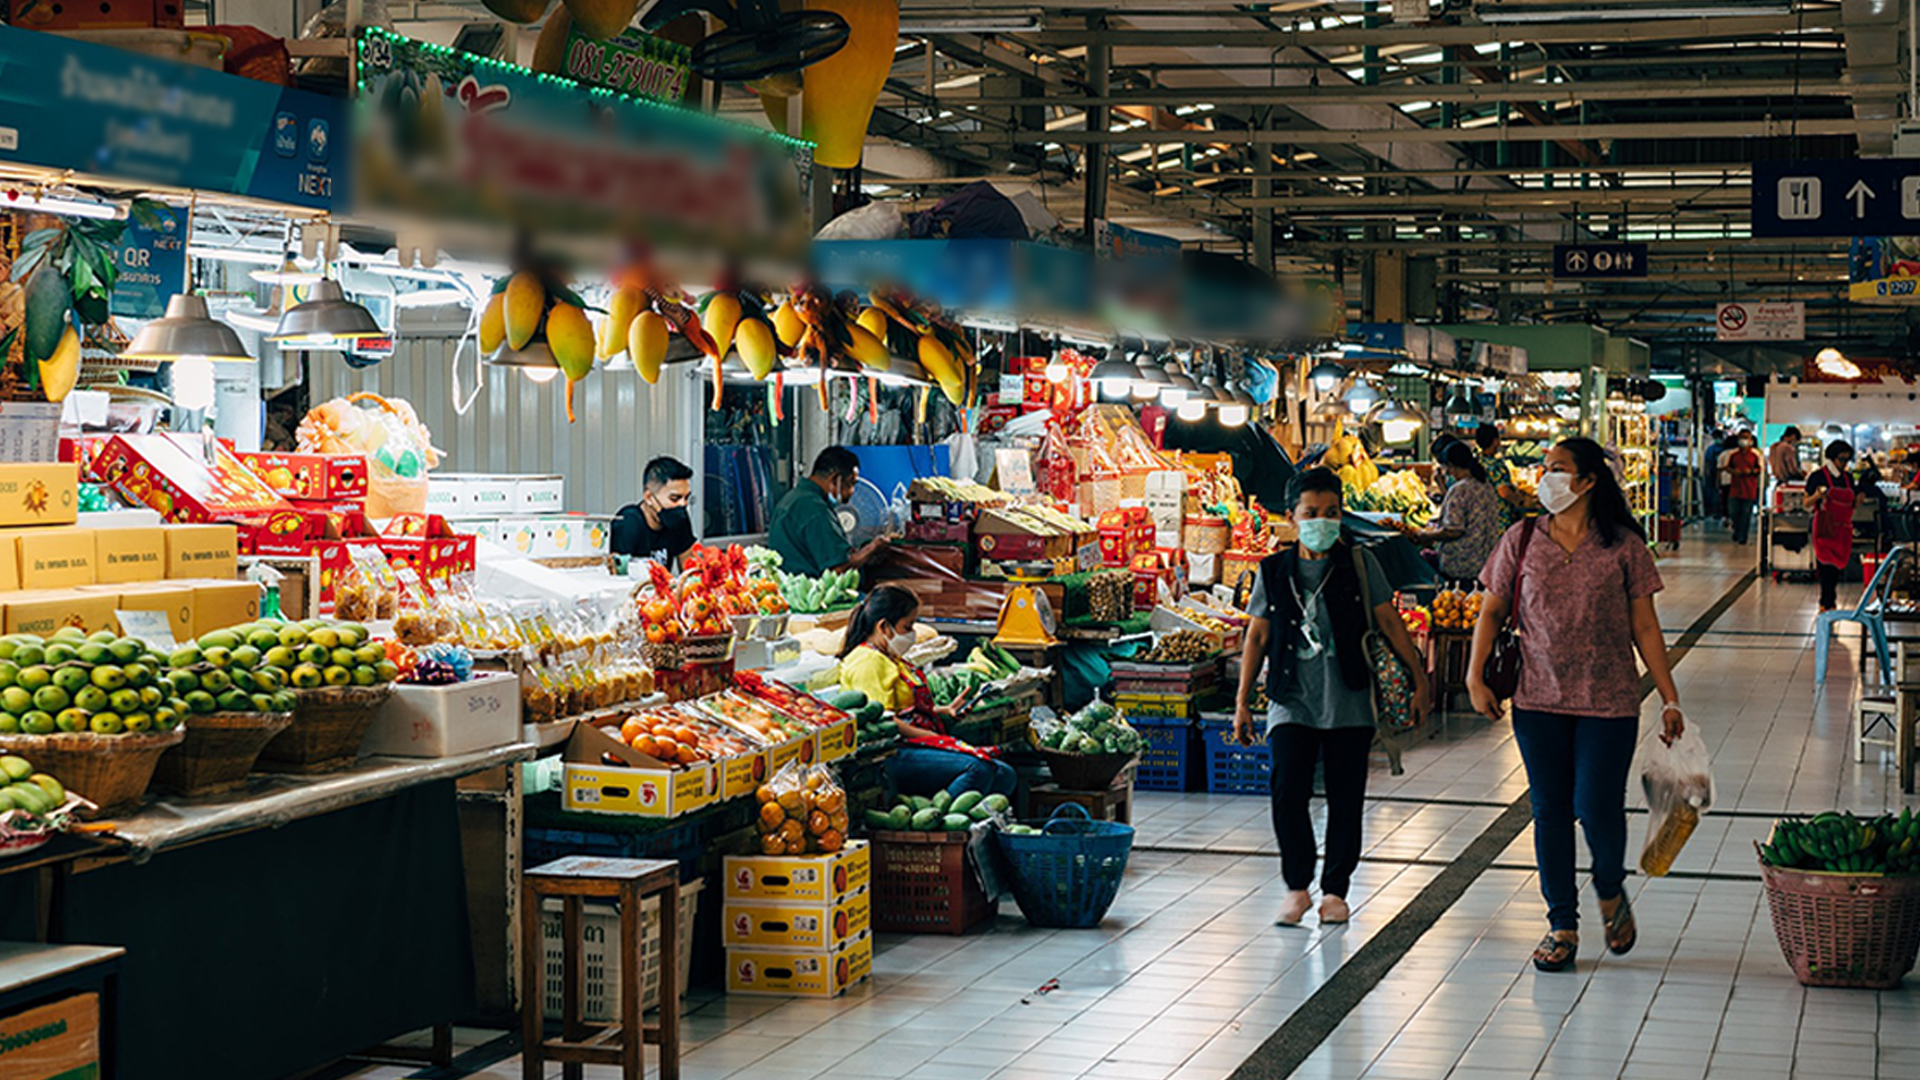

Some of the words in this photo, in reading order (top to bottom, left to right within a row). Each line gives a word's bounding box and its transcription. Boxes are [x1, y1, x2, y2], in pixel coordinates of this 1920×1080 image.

[568, 38, 686, 102] 081-2790074
[298, 173, 331, 196] NEXT
[124, 246, 150, 267] QR
